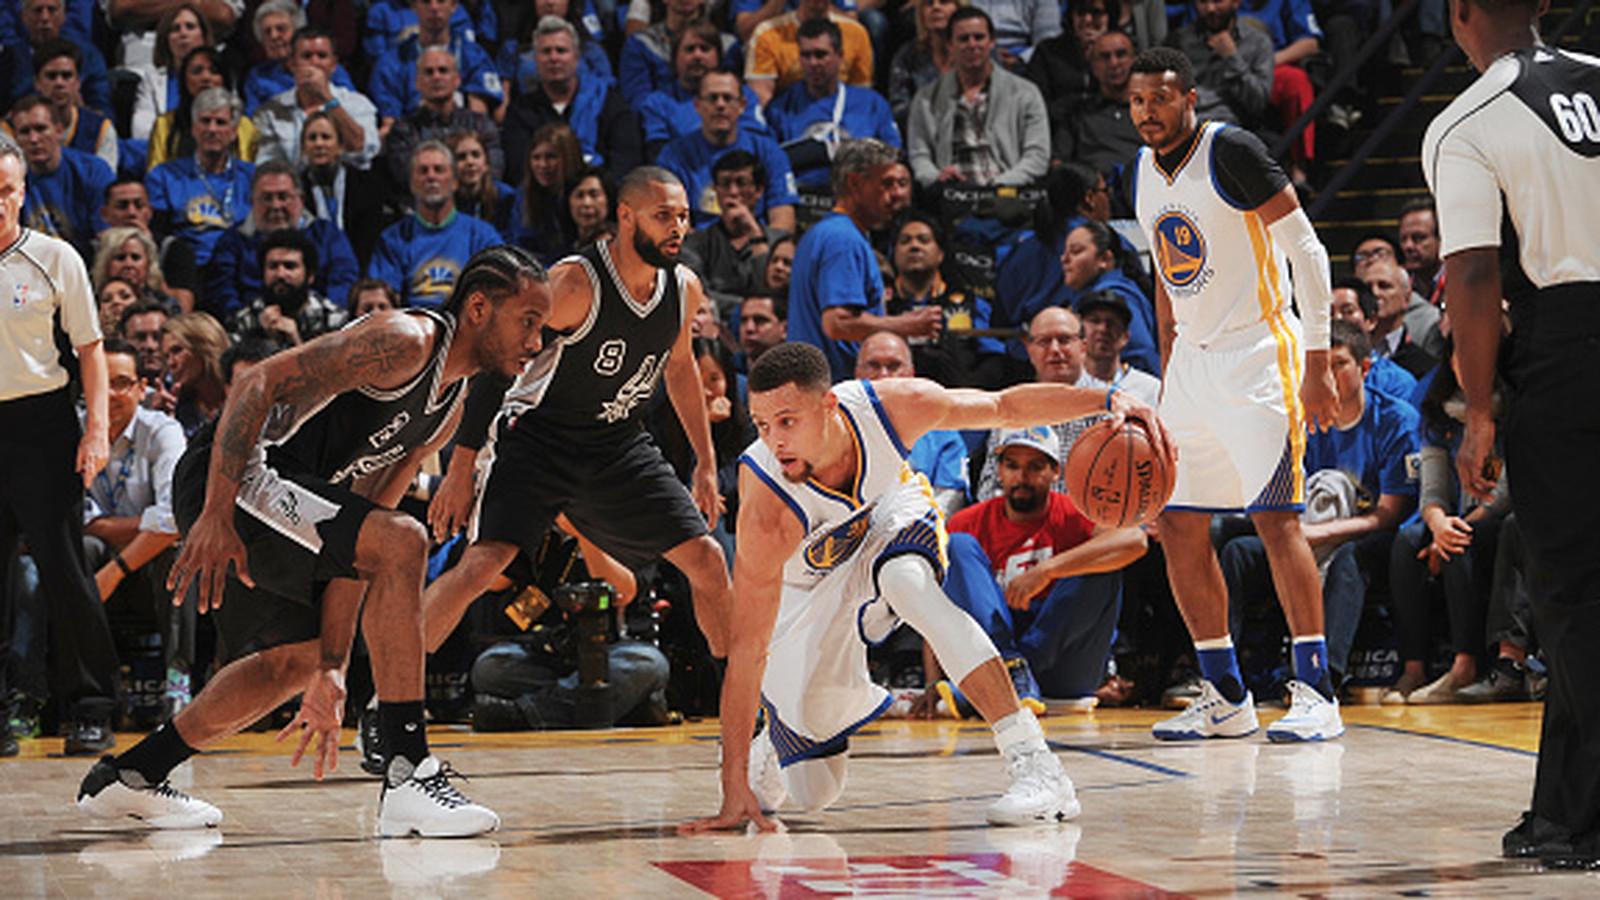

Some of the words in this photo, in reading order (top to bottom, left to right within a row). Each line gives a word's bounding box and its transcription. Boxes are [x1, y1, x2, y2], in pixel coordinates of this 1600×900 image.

[1549, 92, 1600, 143] 60
[1174, 225, 1192, 246] 19
[593, 339, 626, 376] 8
